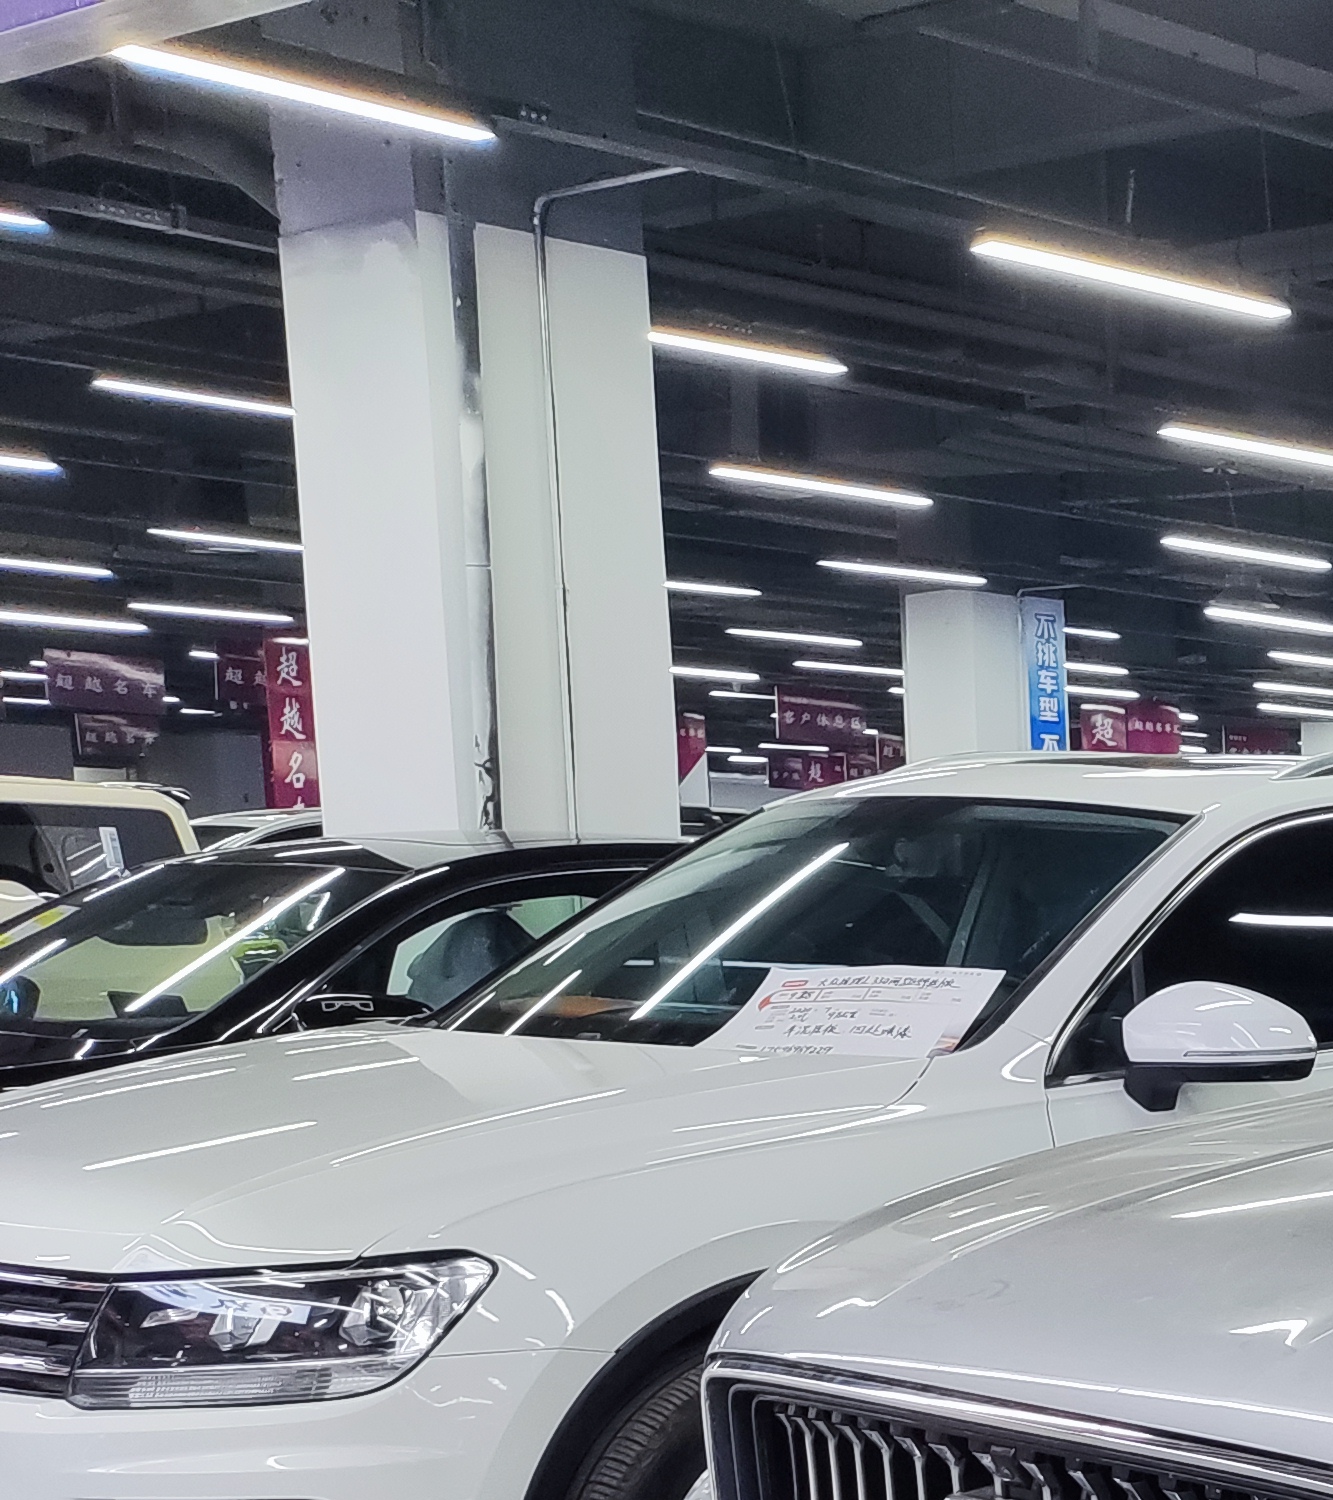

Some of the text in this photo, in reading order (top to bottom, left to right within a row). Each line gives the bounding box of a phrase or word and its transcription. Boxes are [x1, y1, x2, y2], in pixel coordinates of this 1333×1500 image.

[1034, 613, 1060, 722] 不挑车型
[1091, 716, 1118, 747] 超
